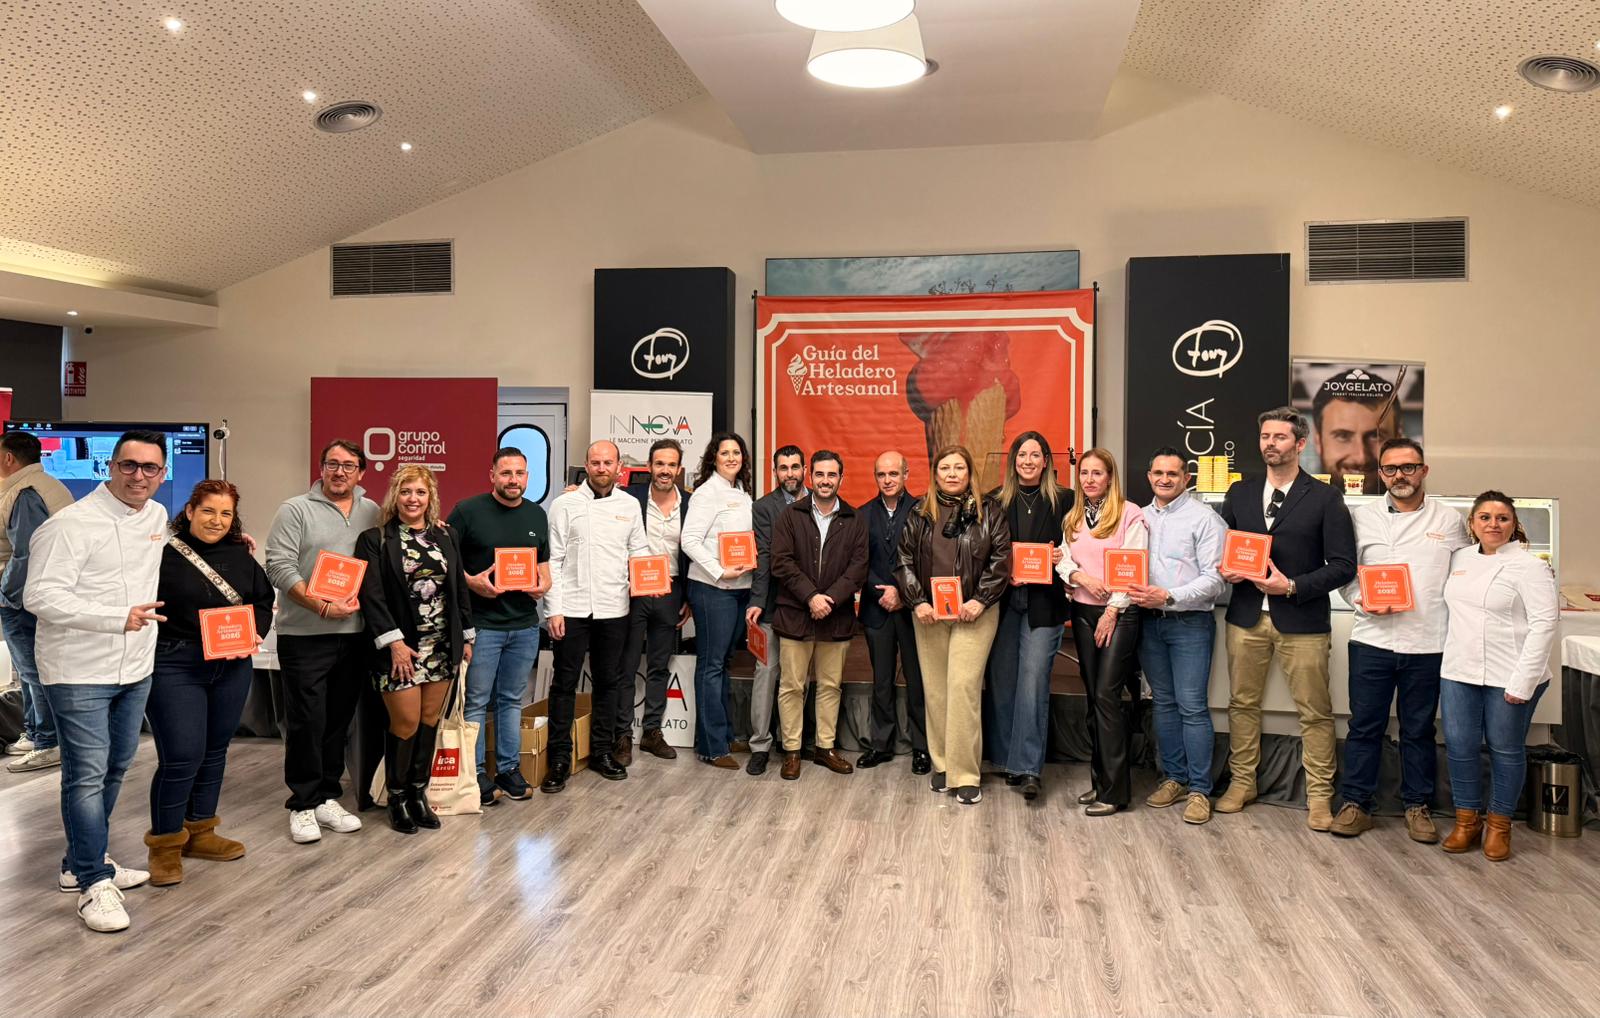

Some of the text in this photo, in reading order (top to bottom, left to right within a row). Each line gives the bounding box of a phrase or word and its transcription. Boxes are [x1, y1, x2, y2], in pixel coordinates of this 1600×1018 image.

[802, 344, 880, 361] Guía del
[808, 362, 896, 379] Heladero
[801, 380, 898, 396] Artesanal
[1324, 381, 1392, 392] JOYGELATO
[398, 431, 440, 444] grupo
[398, 441, 447, 454] control
